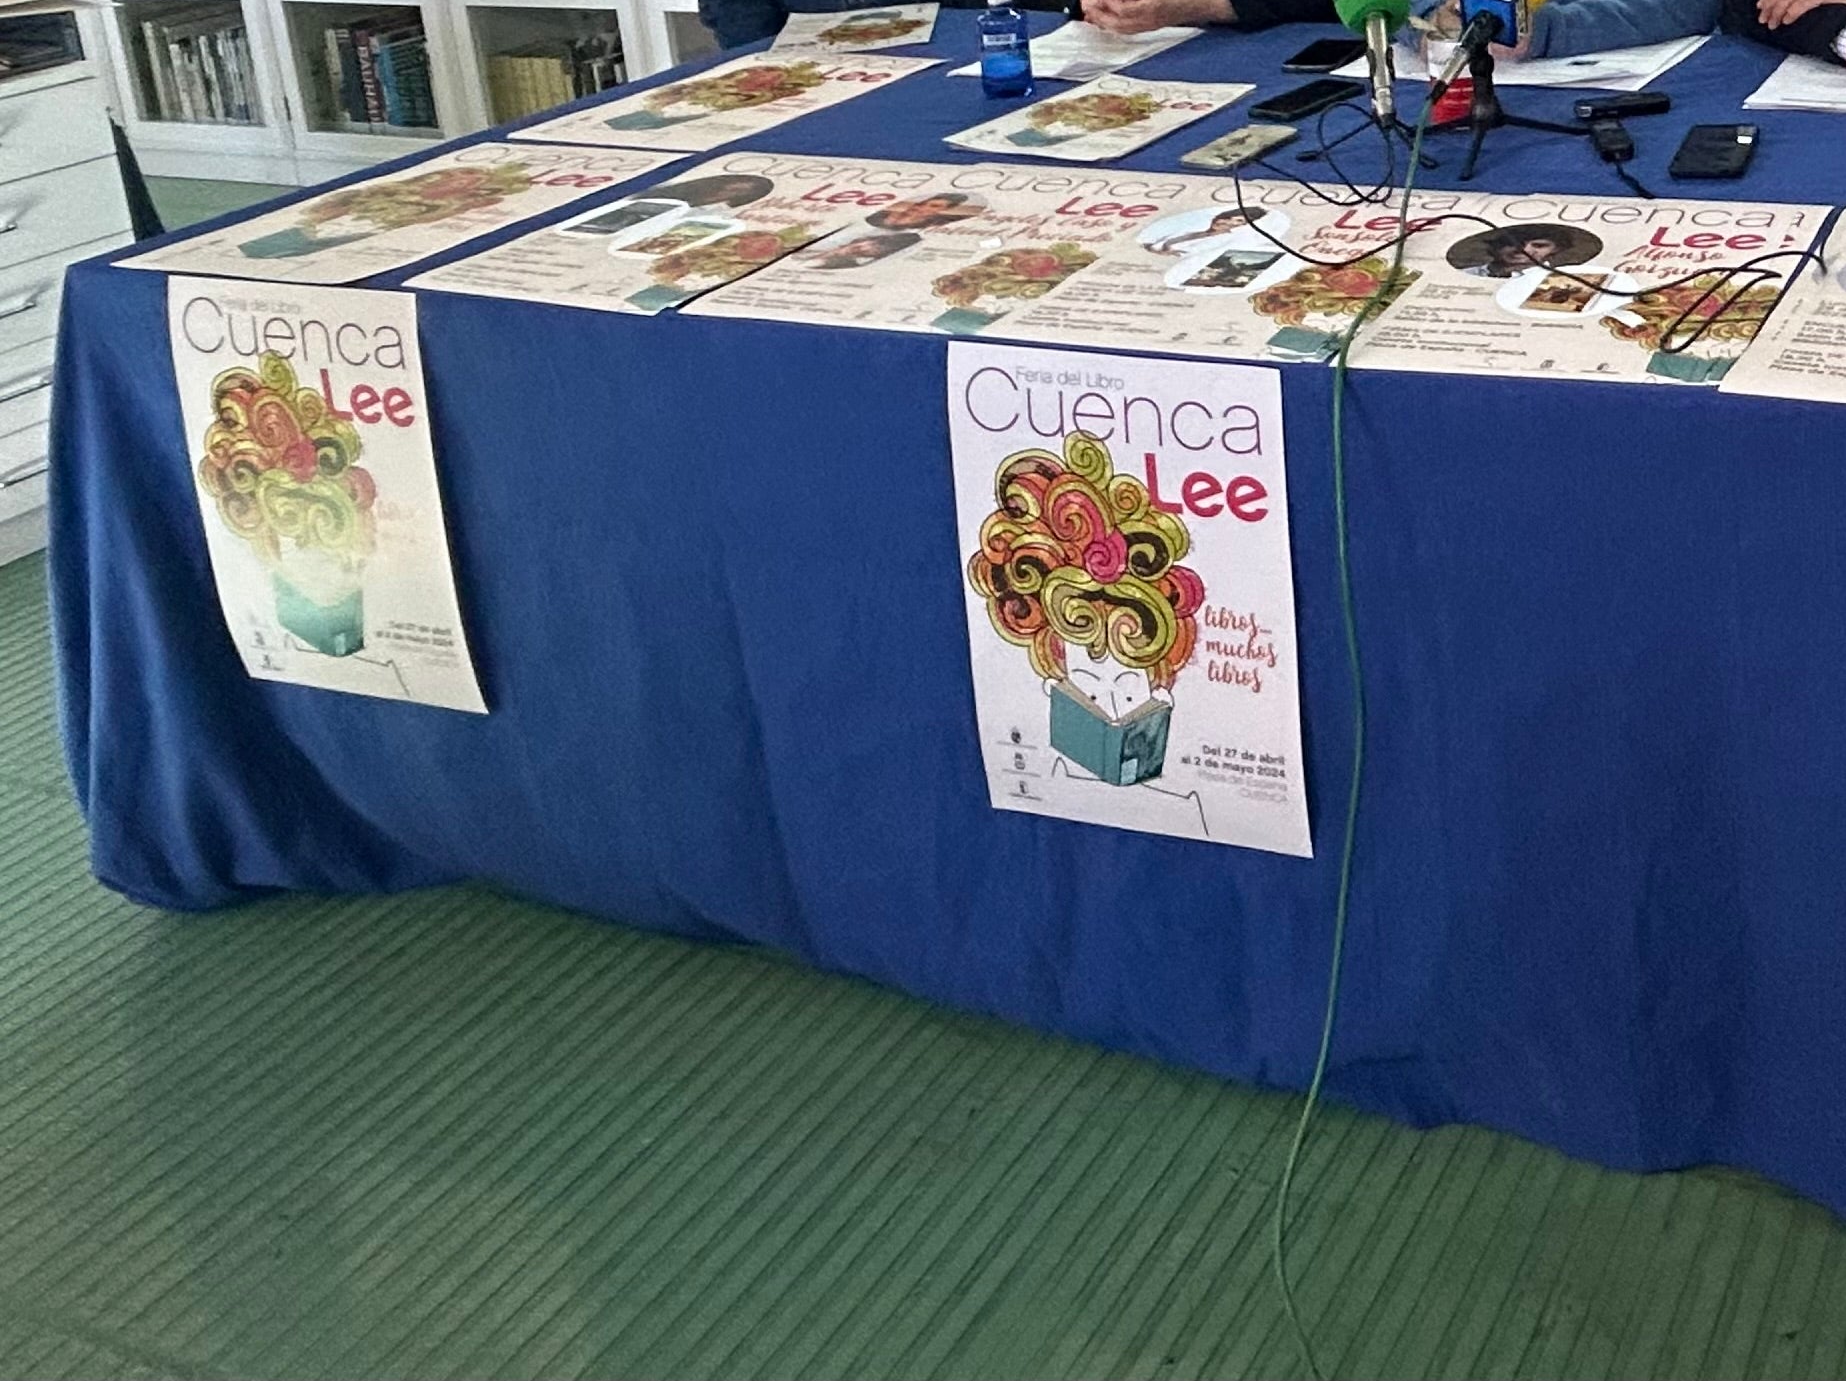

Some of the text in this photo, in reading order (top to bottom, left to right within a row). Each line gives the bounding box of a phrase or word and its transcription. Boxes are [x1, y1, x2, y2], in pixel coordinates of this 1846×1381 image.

[529, 169, 614, 188] Lee
[723, 155, 935, 190] Cuenca
[950, 169, 1187, 199] Cuenca
[801, 182, 896, 206] Lee
[1055, 195, 1159, 218] Lee
[1502, 198, 1775, 229] Cuenca
[1649, 225, 1767, 250] Lee
[183, 296, 406, 370] Cuenca
[1014, 365, 1125, 391] Feria del Libro
[320, 368, 415, 428] Lee
[965, 366, 1264, 456] Cuenca
[1143, 451, 1269, 523] Lee
[1208, 659, 1263, 694] libros
[1193, 757, 1201, 766] 2
[1204, 758, 1219, 769] de
[1222, 762, 1254, 775] mayo
[1257, 765, 1286, 778] 2024
[1202, 744, 1285, 766] Del 27 de abril
